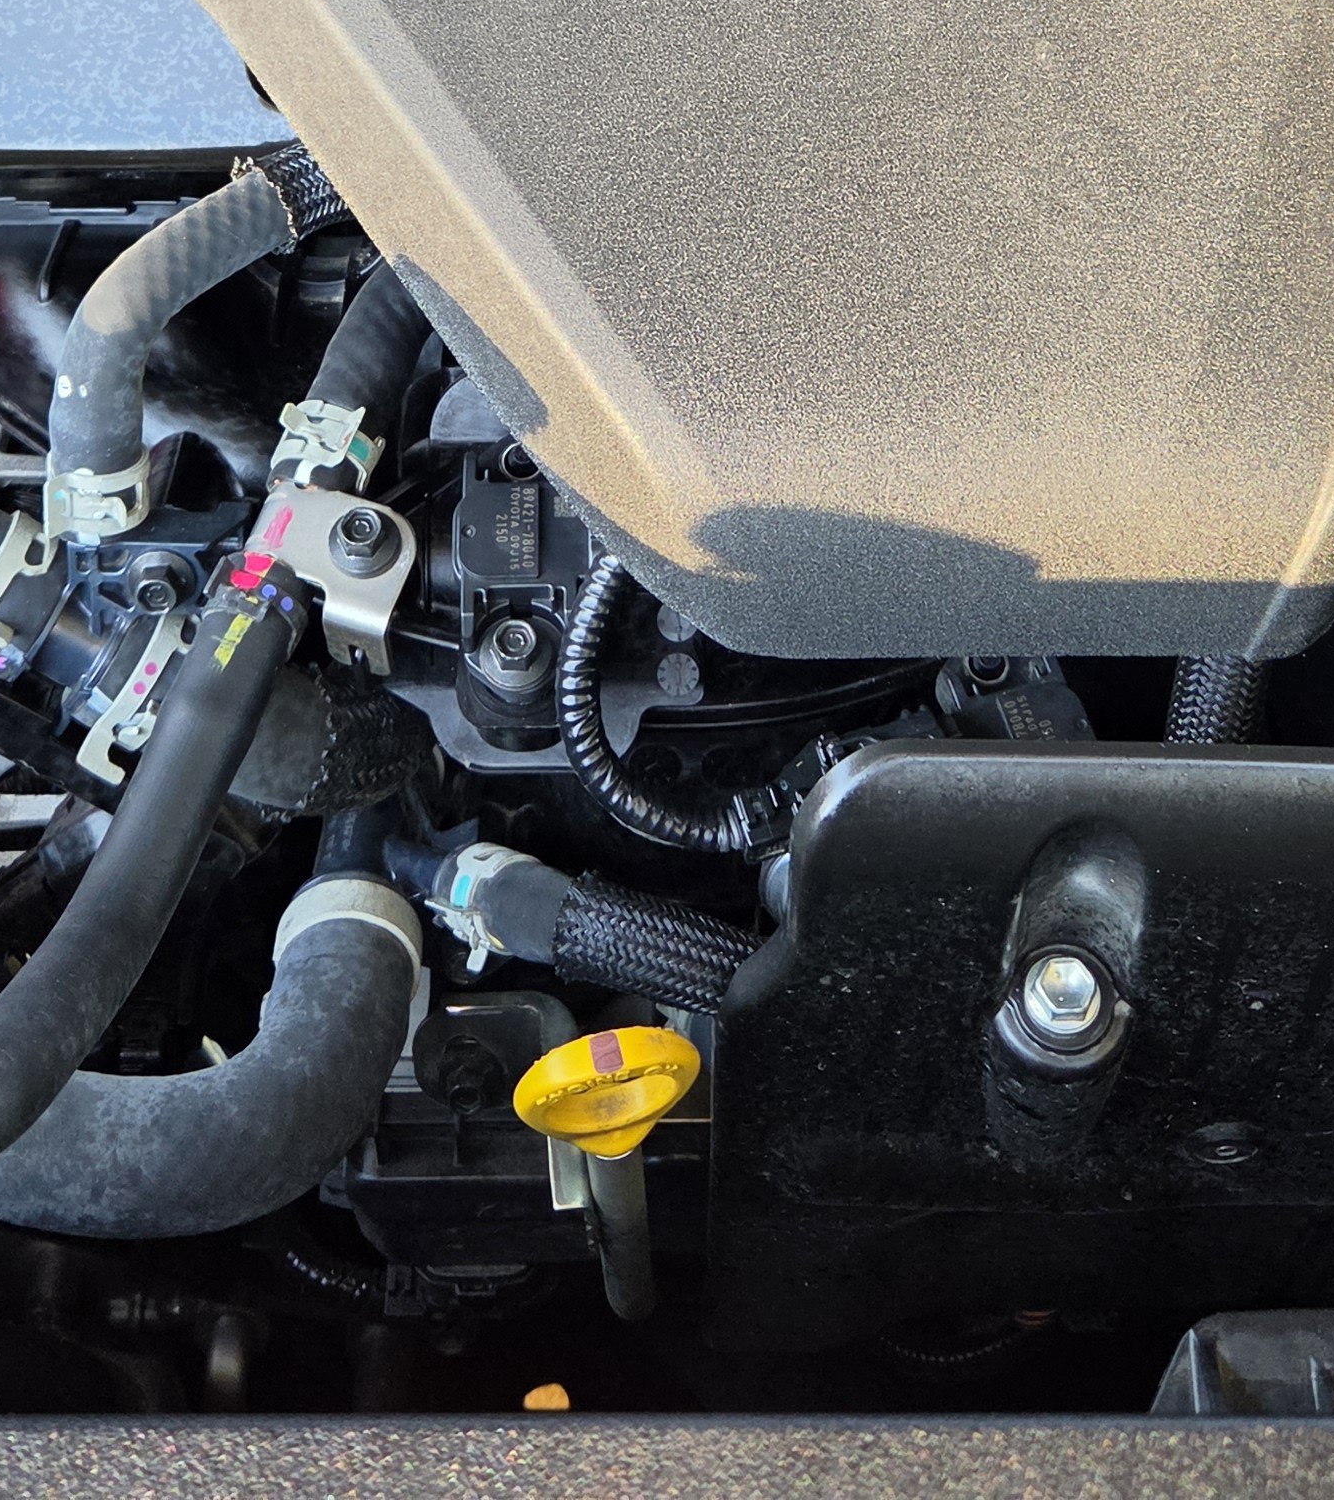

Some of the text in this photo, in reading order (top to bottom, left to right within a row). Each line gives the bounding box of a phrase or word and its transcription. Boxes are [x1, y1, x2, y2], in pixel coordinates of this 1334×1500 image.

[495, 513, 508, 543] 2150
[508, 486, 520, 570] TOYOTA 09J15
[521, 487, 535, 568] 89421-78040
